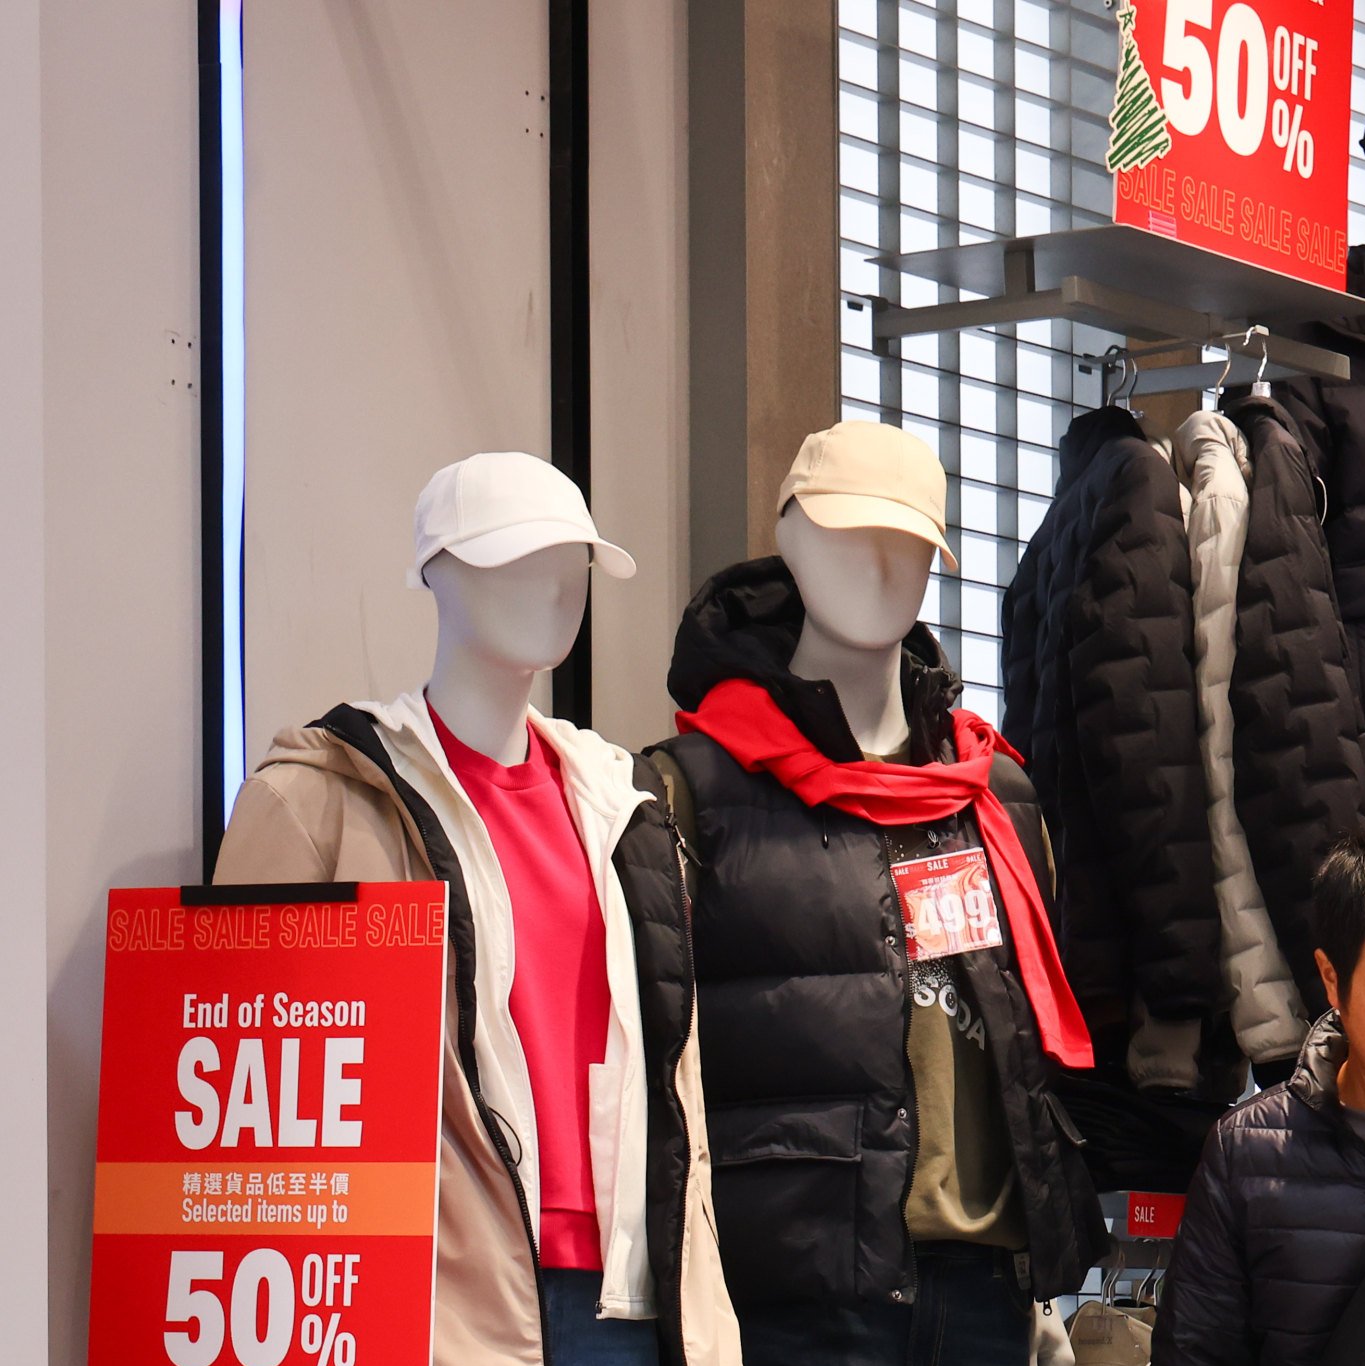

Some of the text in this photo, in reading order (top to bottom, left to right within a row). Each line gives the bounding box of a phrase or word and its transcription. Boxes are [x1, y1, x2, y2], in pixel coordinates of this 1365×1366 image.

[1161, 0, 1318, 156] 50 OFF
[1272, 99, 1314, 178] %
[1119, 164, 1348, 274] SALE SALE SALE SALE
[927, 859, 949, 871] SALE
[110, 903, 444, 951] SALE SALE SALE SALE
[183, 992, 366, 1028] End of Season
[174, 1036, 365, 1150] SALE
[182, 1172, 350, 1196] 精選貨品低至半價
[182, 1198, 347, 1229] Selected items up to
[1134, 1206, 1155, 1223] SALE
[300, 1253, 361, 1307] OFF
